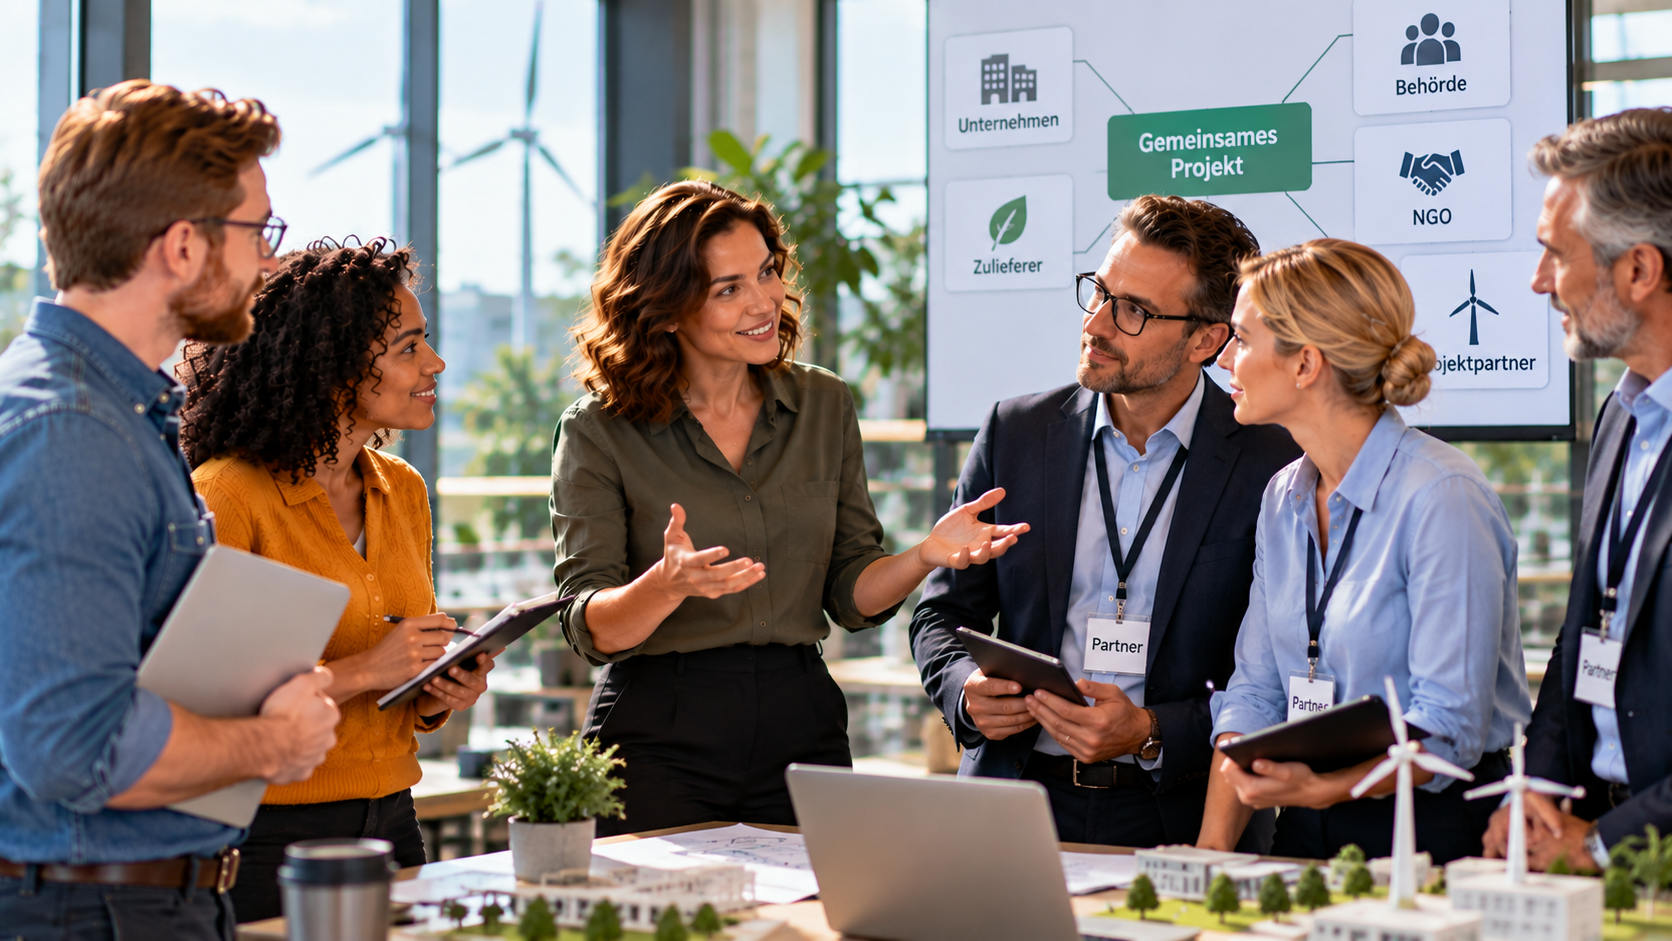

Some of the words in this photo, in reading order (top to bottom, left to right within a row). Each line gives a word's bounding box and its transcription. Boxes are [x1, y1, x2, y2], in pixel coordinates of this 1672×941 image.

[1395, 74, 1467, 96] Behörde
[957, 112, 1060, 134] Unternehmen
[1138, 126, 1279, 153] Gemeinsames
[1171, 154, 1245, 182] Projekt
[1412, 207, 1453, 226] NGO
[972, 257, 1044, 276] Zulieferer
[1434, 354, 1537, 375] ojektpartner
[1092, 637, 1144, 654] Partner
[1292, 695, 1329, 712] Partner
